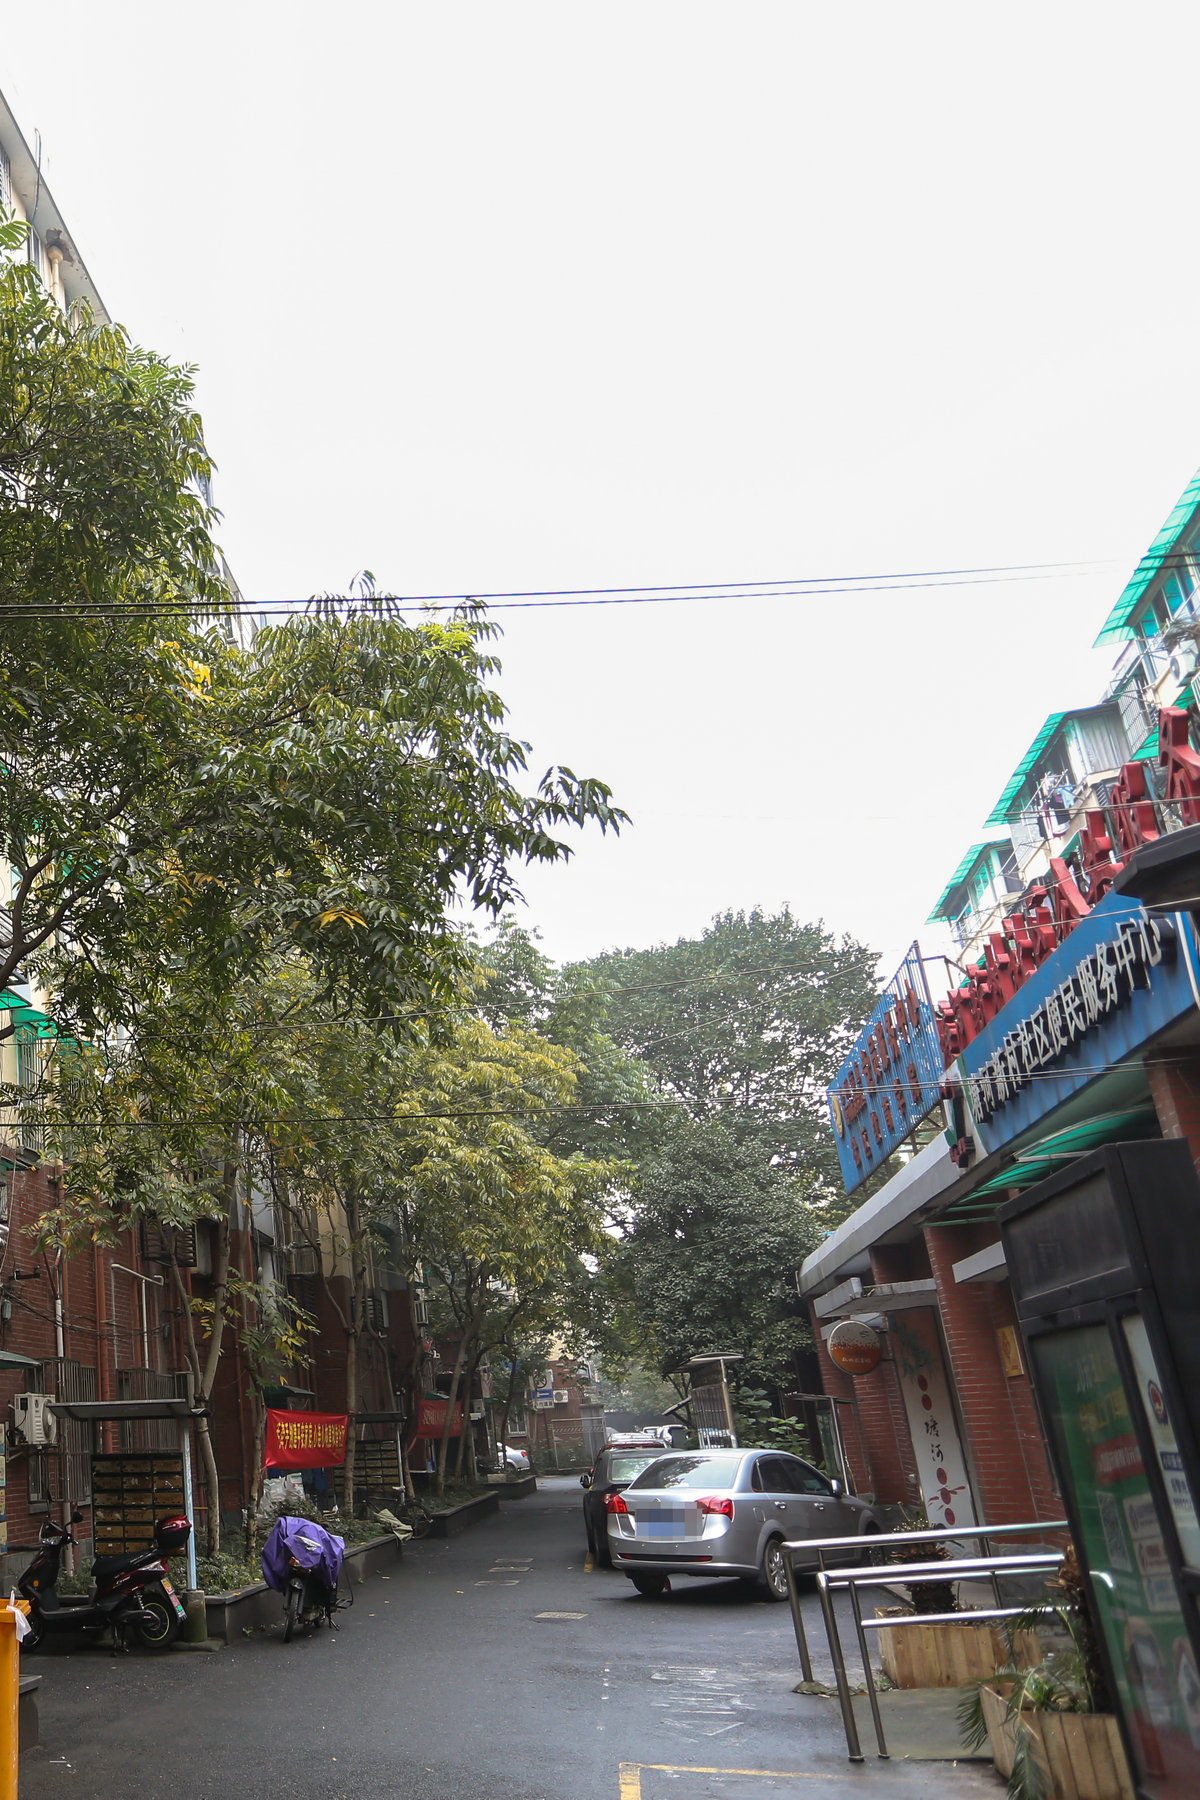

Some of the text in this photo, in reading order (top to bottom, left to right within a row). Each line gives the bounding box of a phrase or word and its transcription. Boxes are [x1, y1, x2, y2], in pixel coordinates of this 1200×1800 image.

[968, 906, 1173, 1123] 塘河新村社区便民服务中心
[924, 1415, 944, 1463] 塘河
